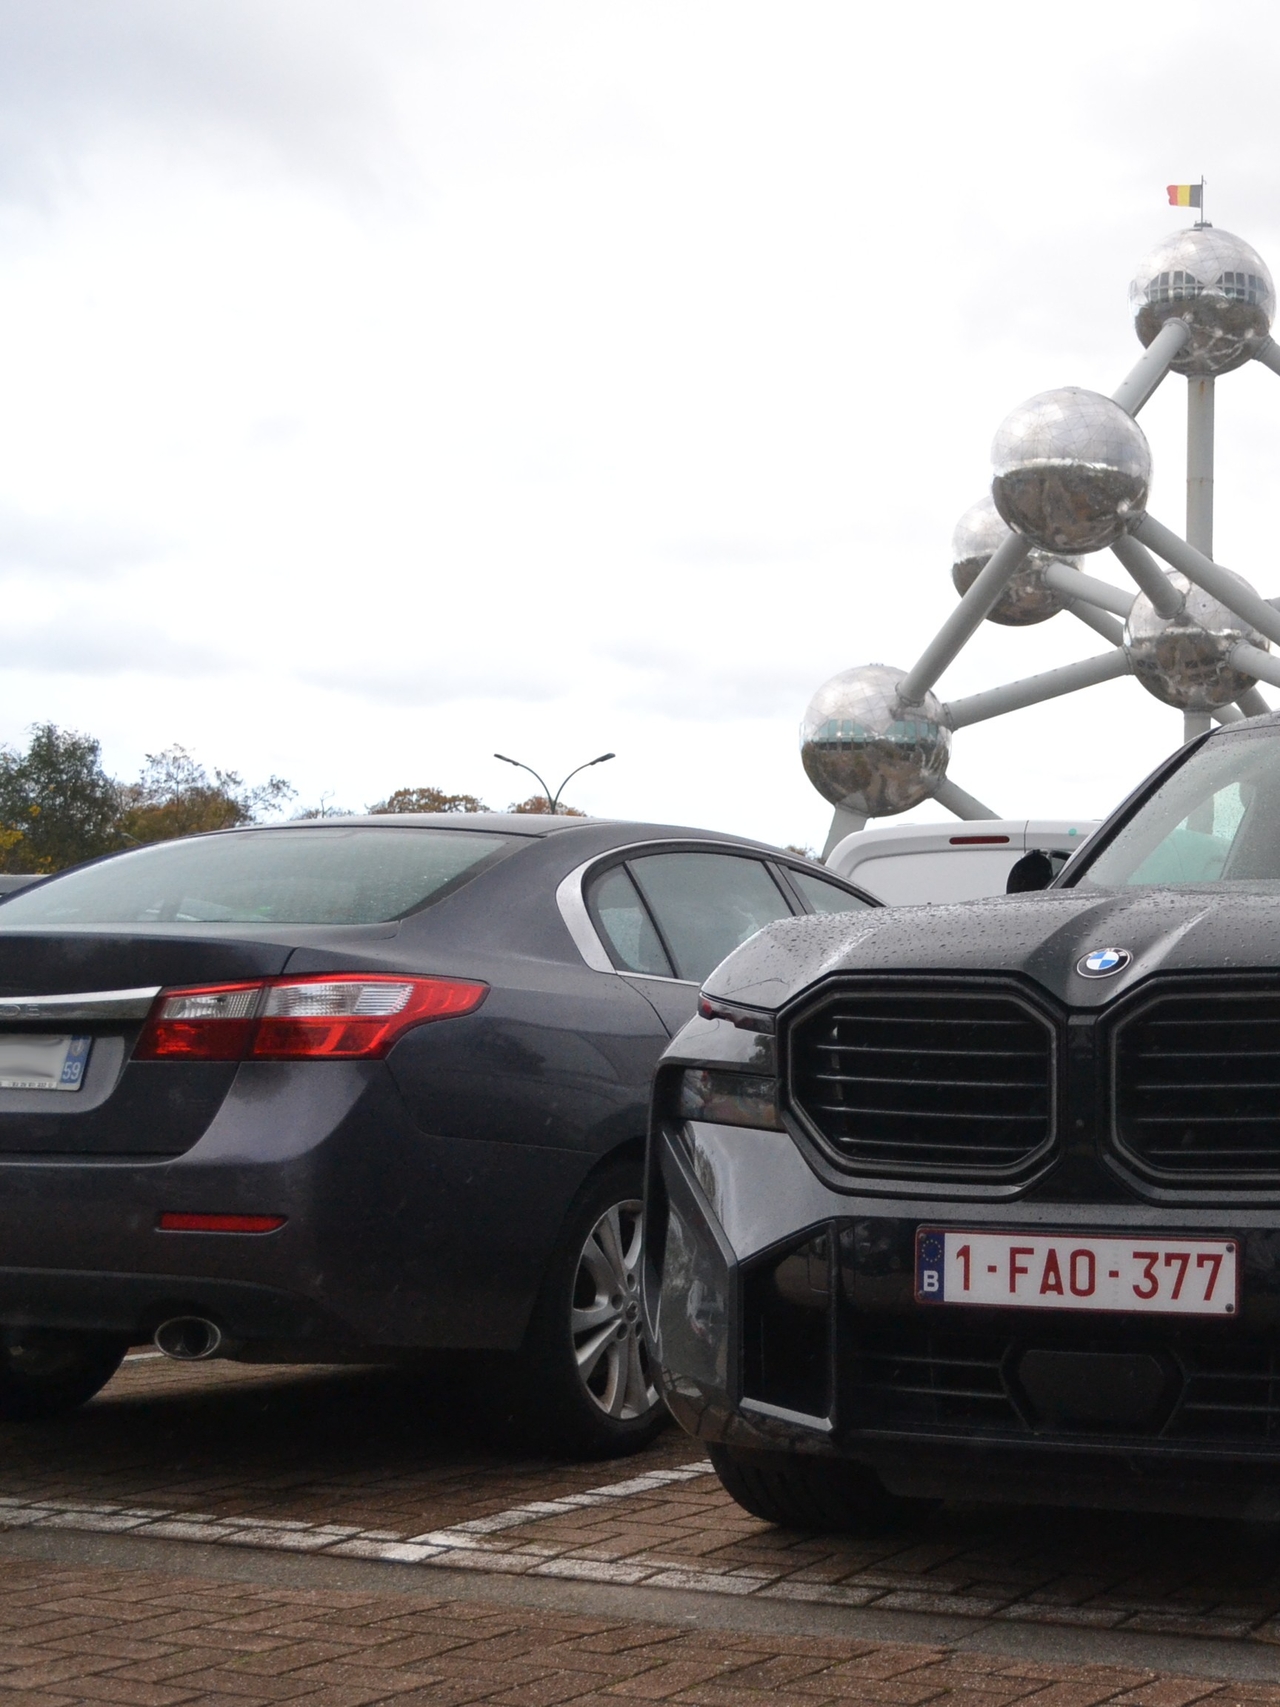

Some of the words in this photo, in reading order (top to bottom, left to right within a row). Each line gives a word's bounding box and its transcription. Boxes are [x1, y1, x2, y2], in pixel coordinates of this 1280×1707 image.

[62, 1061, 81, 1080] 59
[923, 1270, 939, 1293] B
[955, 1244, 1224, 1301] 1-FAO-377
